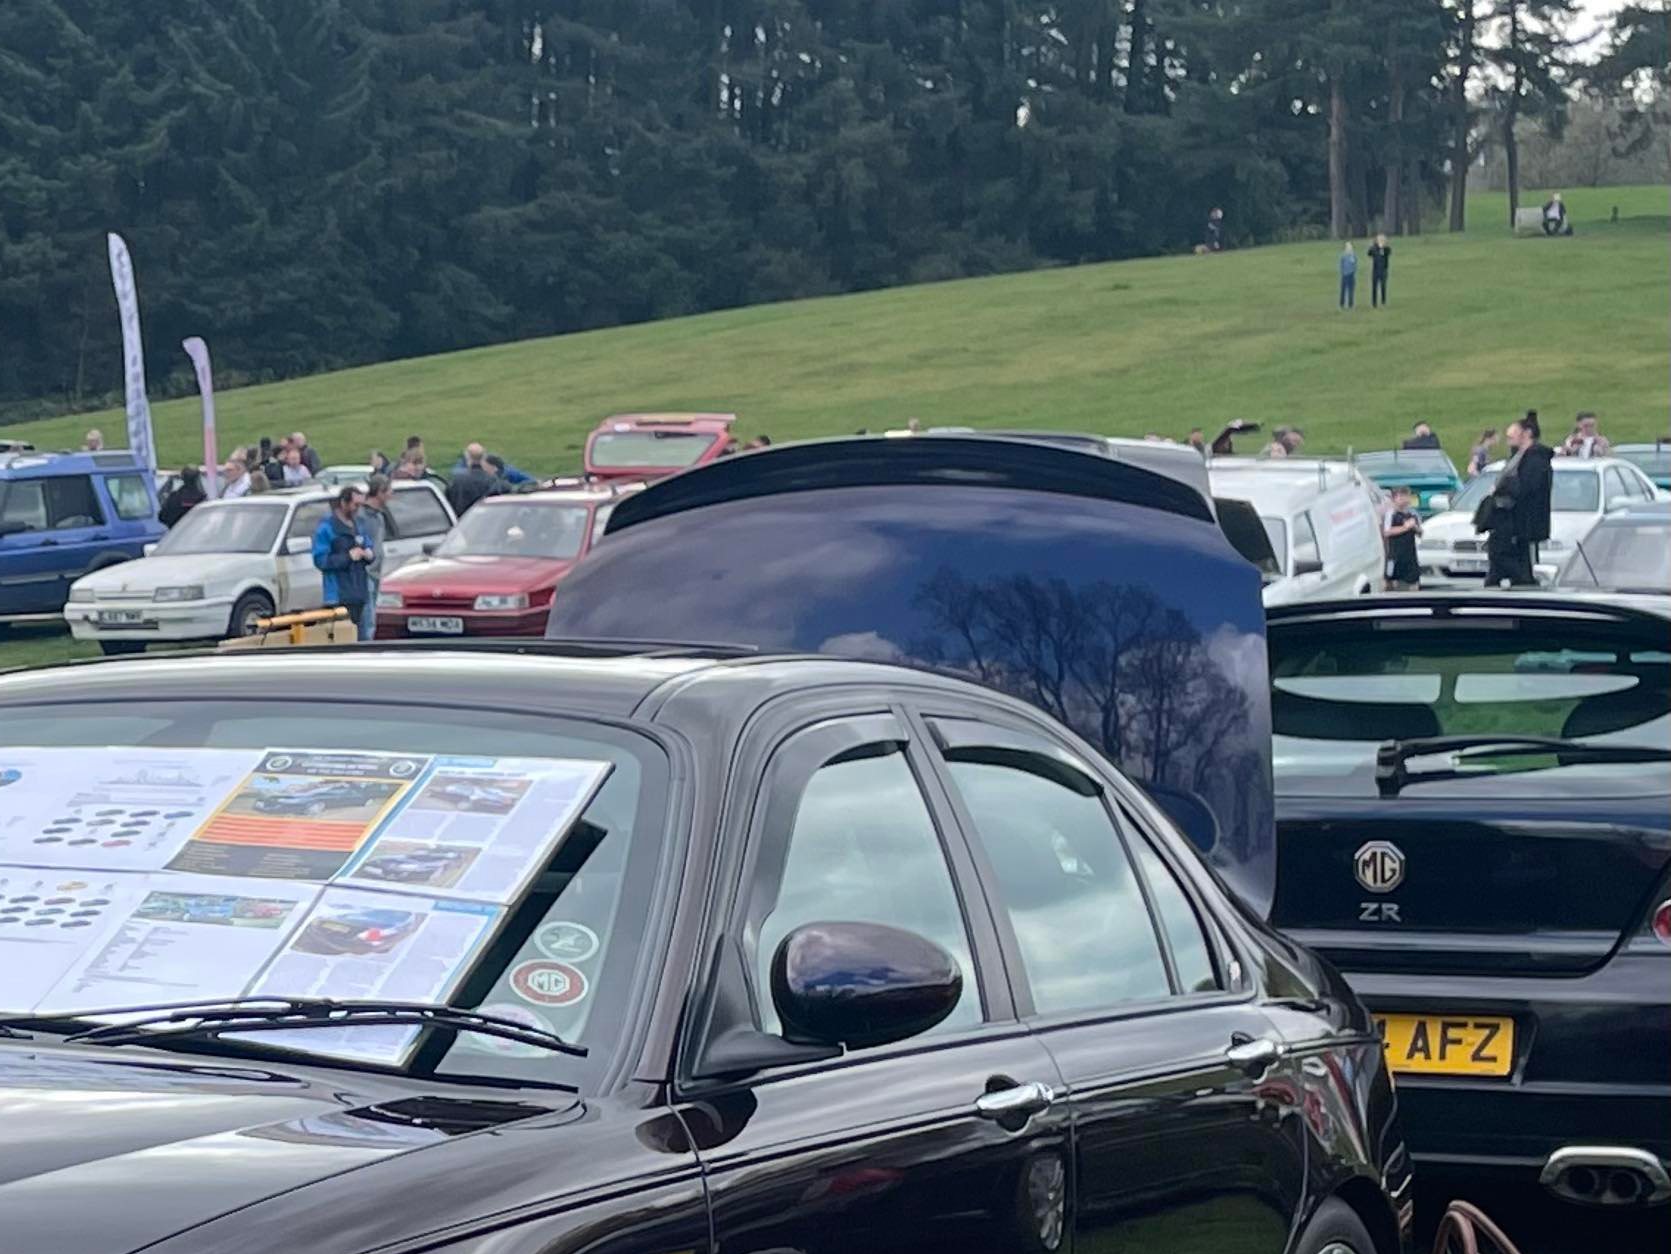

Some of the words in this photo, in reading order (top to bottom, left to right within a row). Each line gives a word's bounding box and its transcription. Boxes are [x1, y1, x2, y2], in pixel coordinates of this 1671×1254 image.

[1359, 849, 1400, 888] MG
[1359, 902, 1402, 922] ZR
[531, 971, 567, 993] MG
[1406, 1020, 1501, 1063] AFZ
